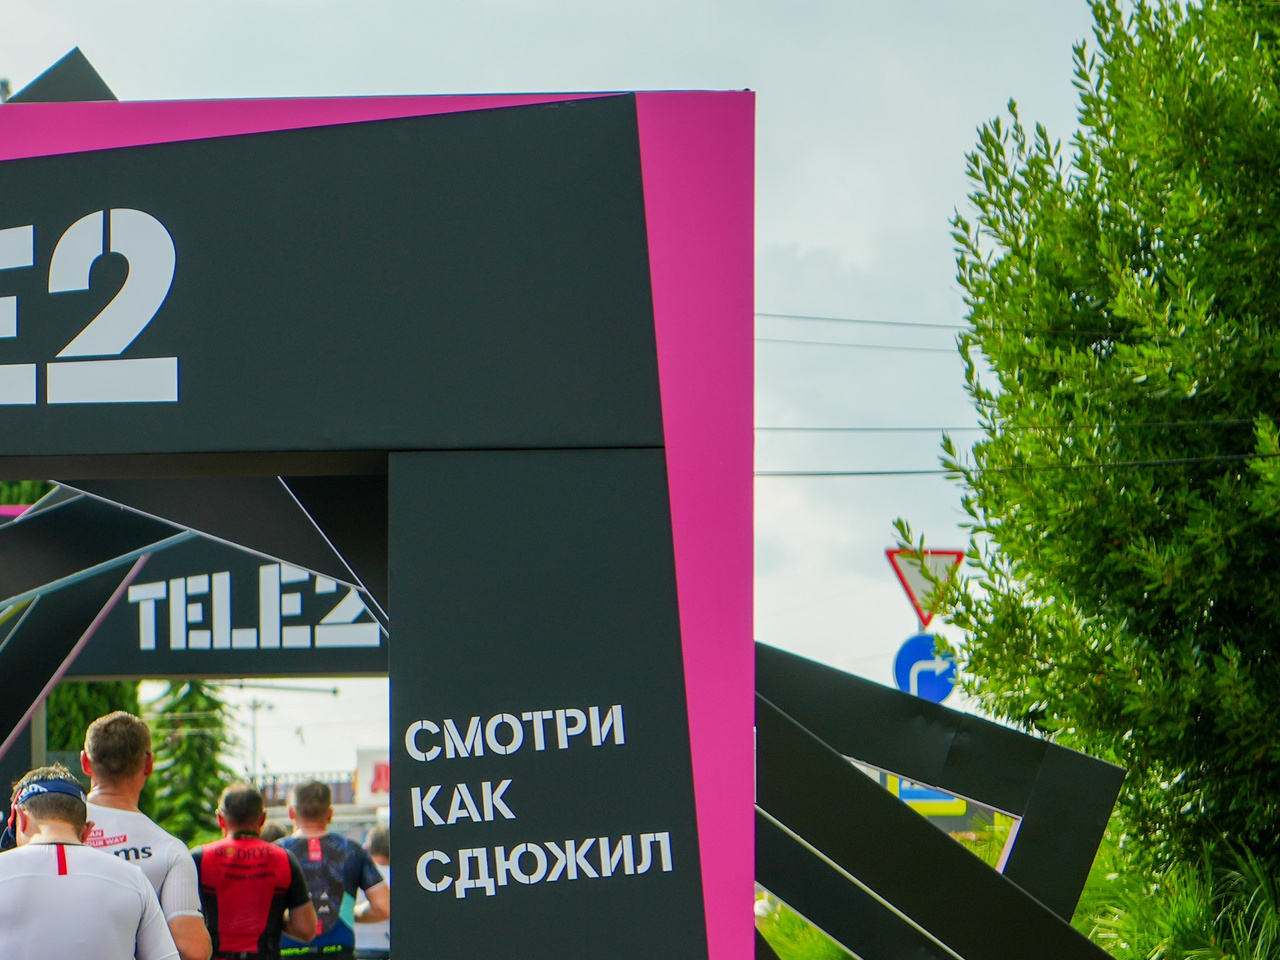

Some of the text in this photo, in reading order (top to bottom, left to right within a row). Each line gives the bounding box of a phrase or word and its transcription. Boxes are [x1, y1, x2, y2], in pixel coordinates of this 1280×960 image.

[127, 562, 381, 651] TELE2
[404, 704, 626, 762] СМОТРИ
[410, 779, 517, 827] КАК
[106, 835, 125, 845] WAY
[415, 831, 673, 898] СДЮЖИЛ
